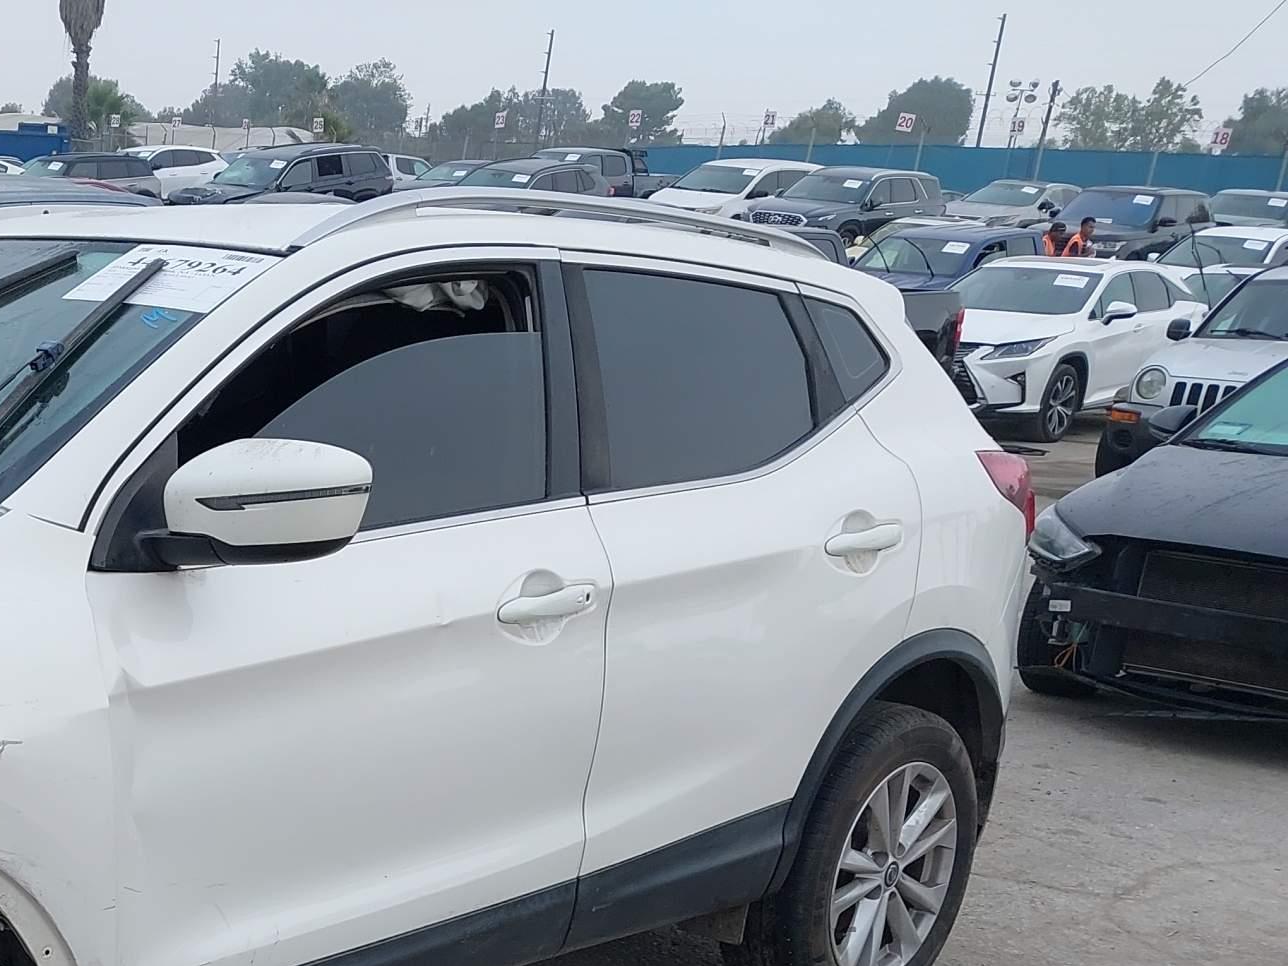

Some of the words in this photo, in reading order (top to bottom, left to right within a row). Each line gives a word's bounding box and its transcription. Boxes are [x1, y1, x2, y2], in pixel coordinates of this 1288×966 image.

[172, 119, 181, 127] 27
[496, 116, 505, 125] 23
[630, 113, 641, 124] 22
[764, 114, 775, 125] 21
[898, 116, 913, 129] 20
[1010, 120, 1025, 132] 19
[1210, 131, 1229, 145] 18
